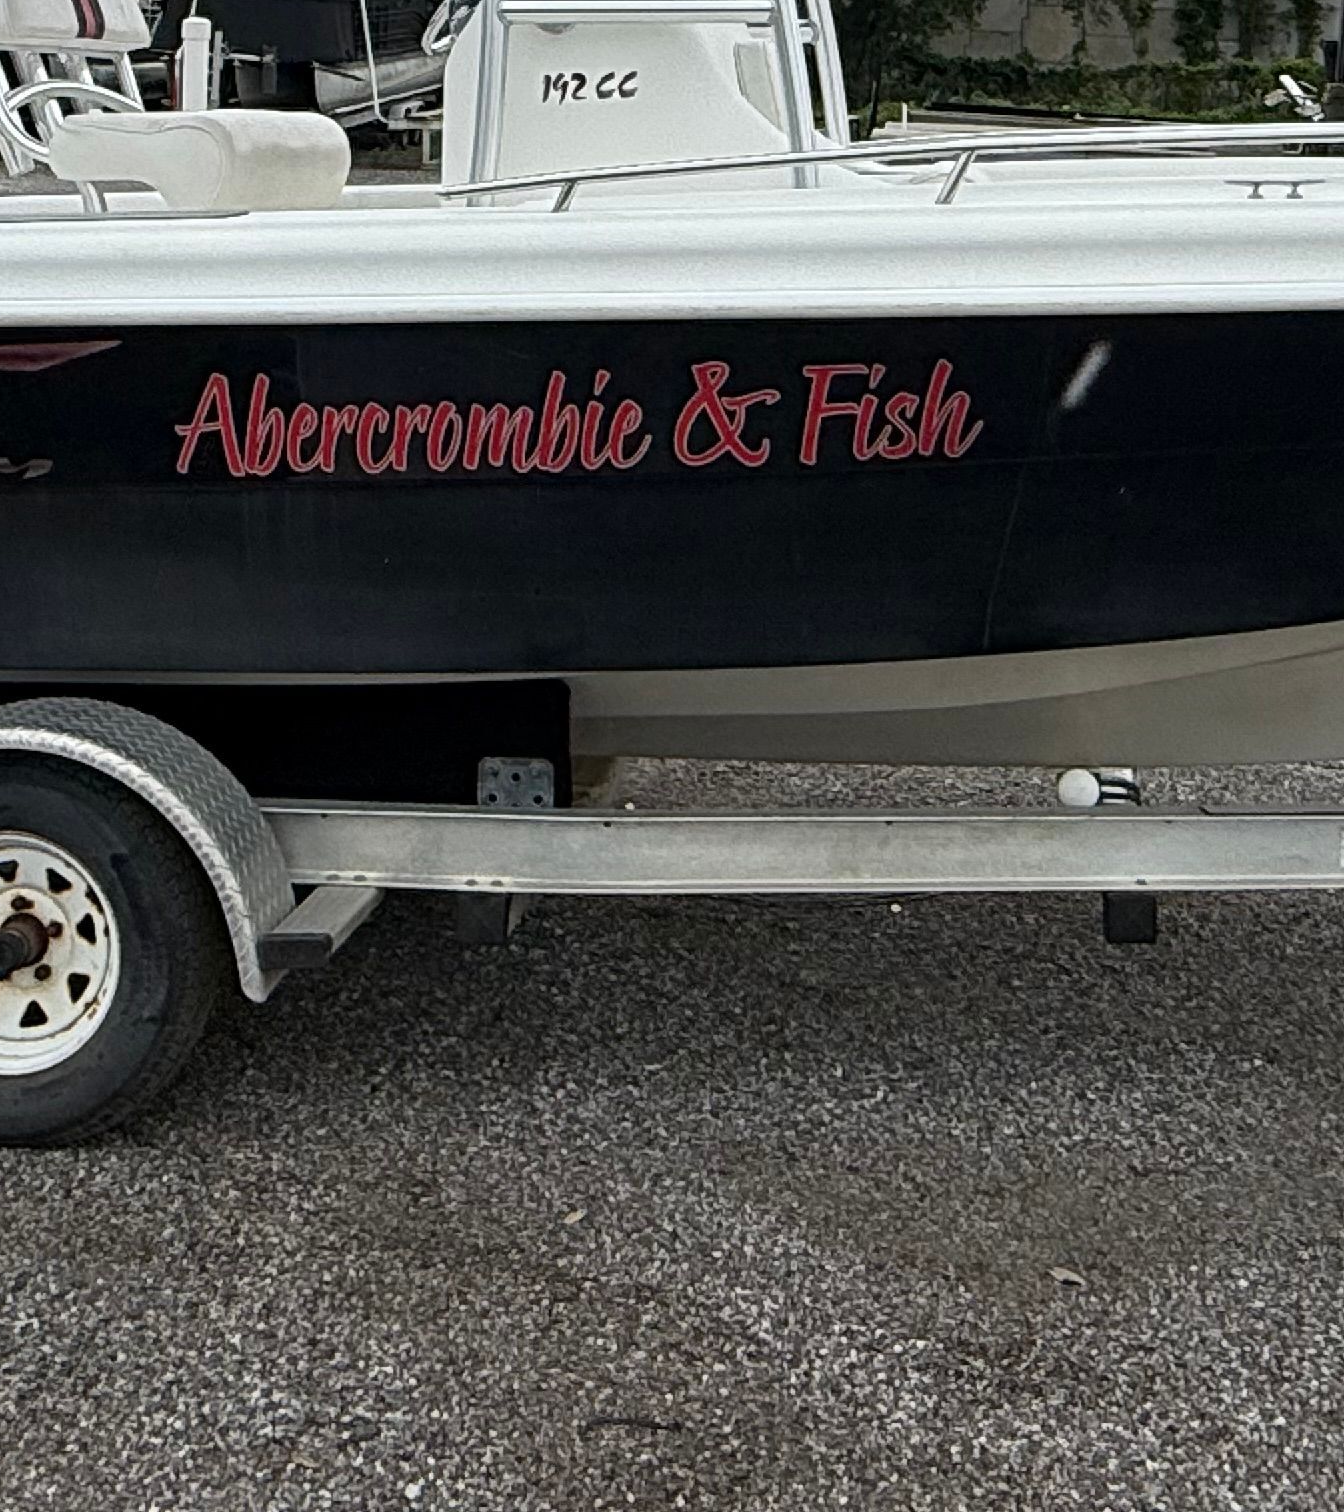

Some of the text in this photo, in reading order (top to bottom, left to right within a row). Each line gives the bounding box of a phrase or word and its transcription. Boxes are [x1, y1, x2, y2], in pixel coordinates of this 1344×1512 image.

[542, 71, 638, 105] 192 CC
[175, 357, 985, 477] Abercrombie & Fish
